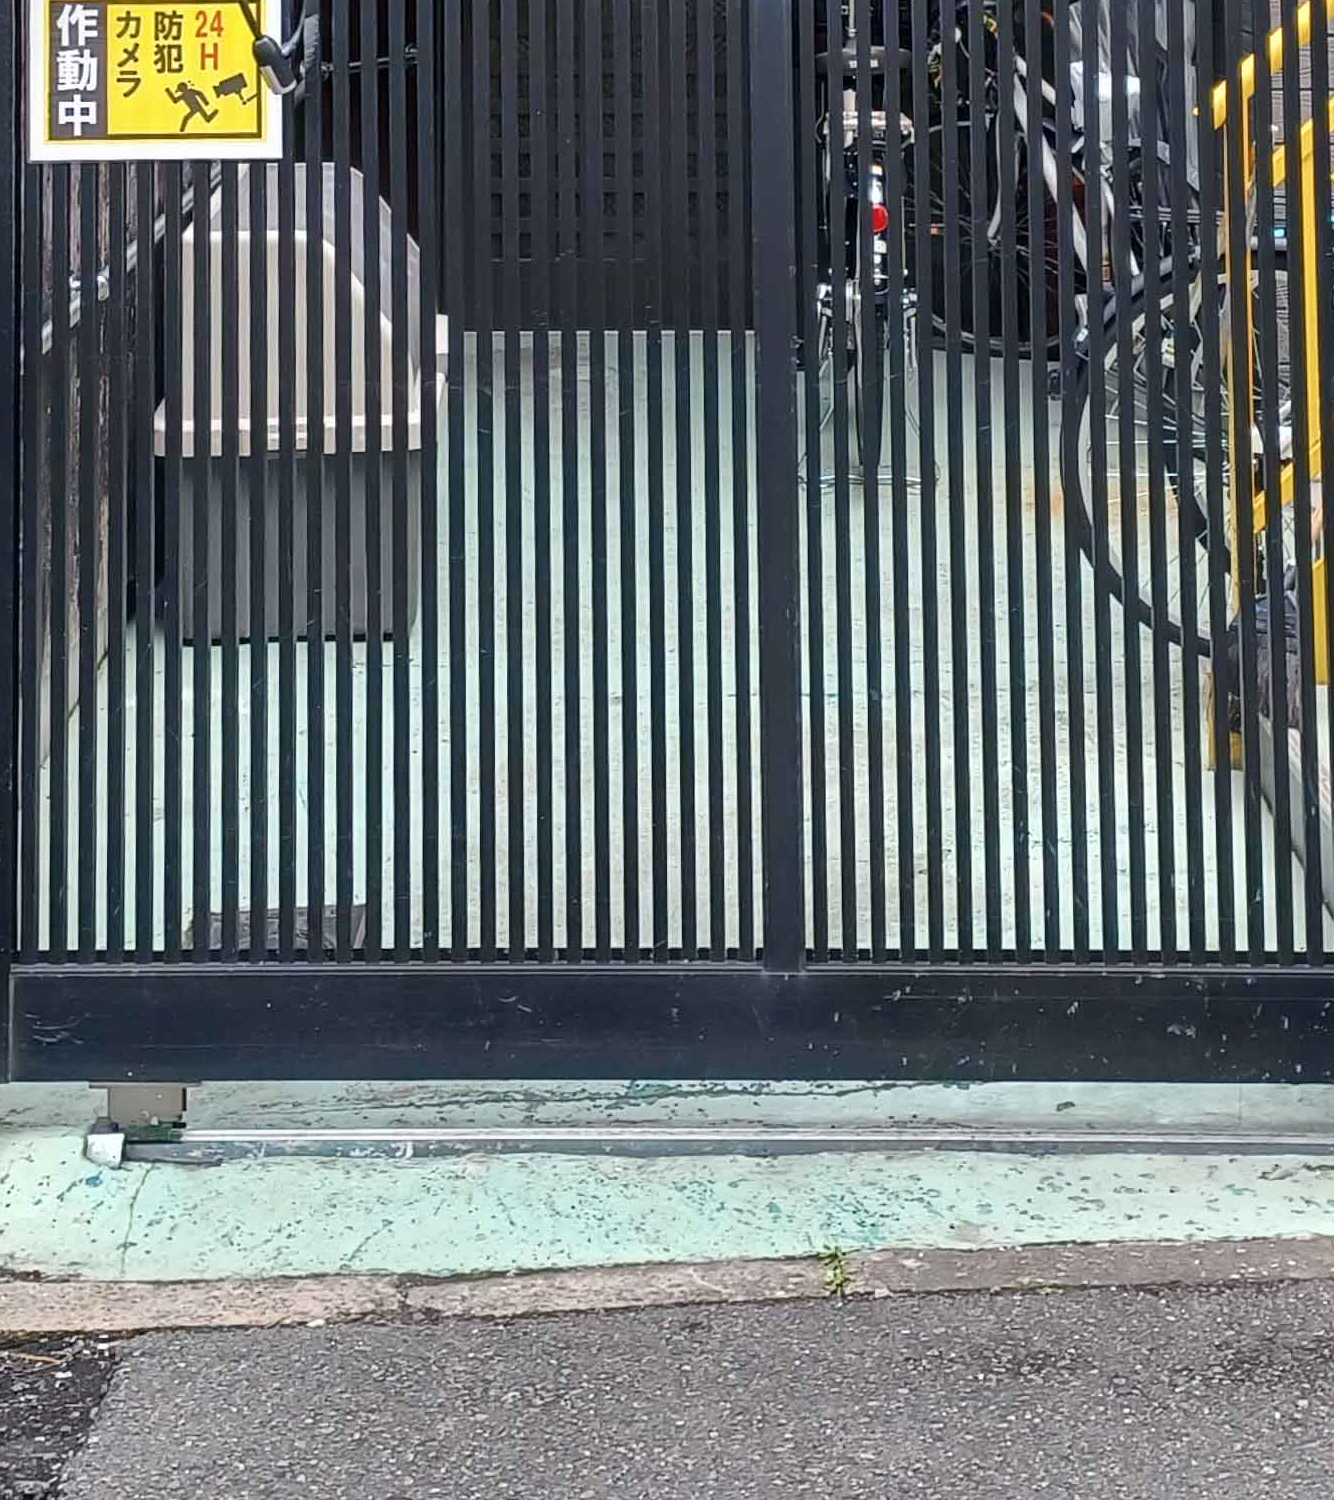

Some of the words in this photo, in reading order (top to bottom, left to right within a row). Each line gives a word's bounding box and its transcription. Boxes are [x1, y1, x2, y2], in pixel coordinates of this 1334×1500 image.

[56, 3, 99, 137] 作動中
[115, 10, 142, 98] カメラ
[153, 10, 184, 74] 防犯
